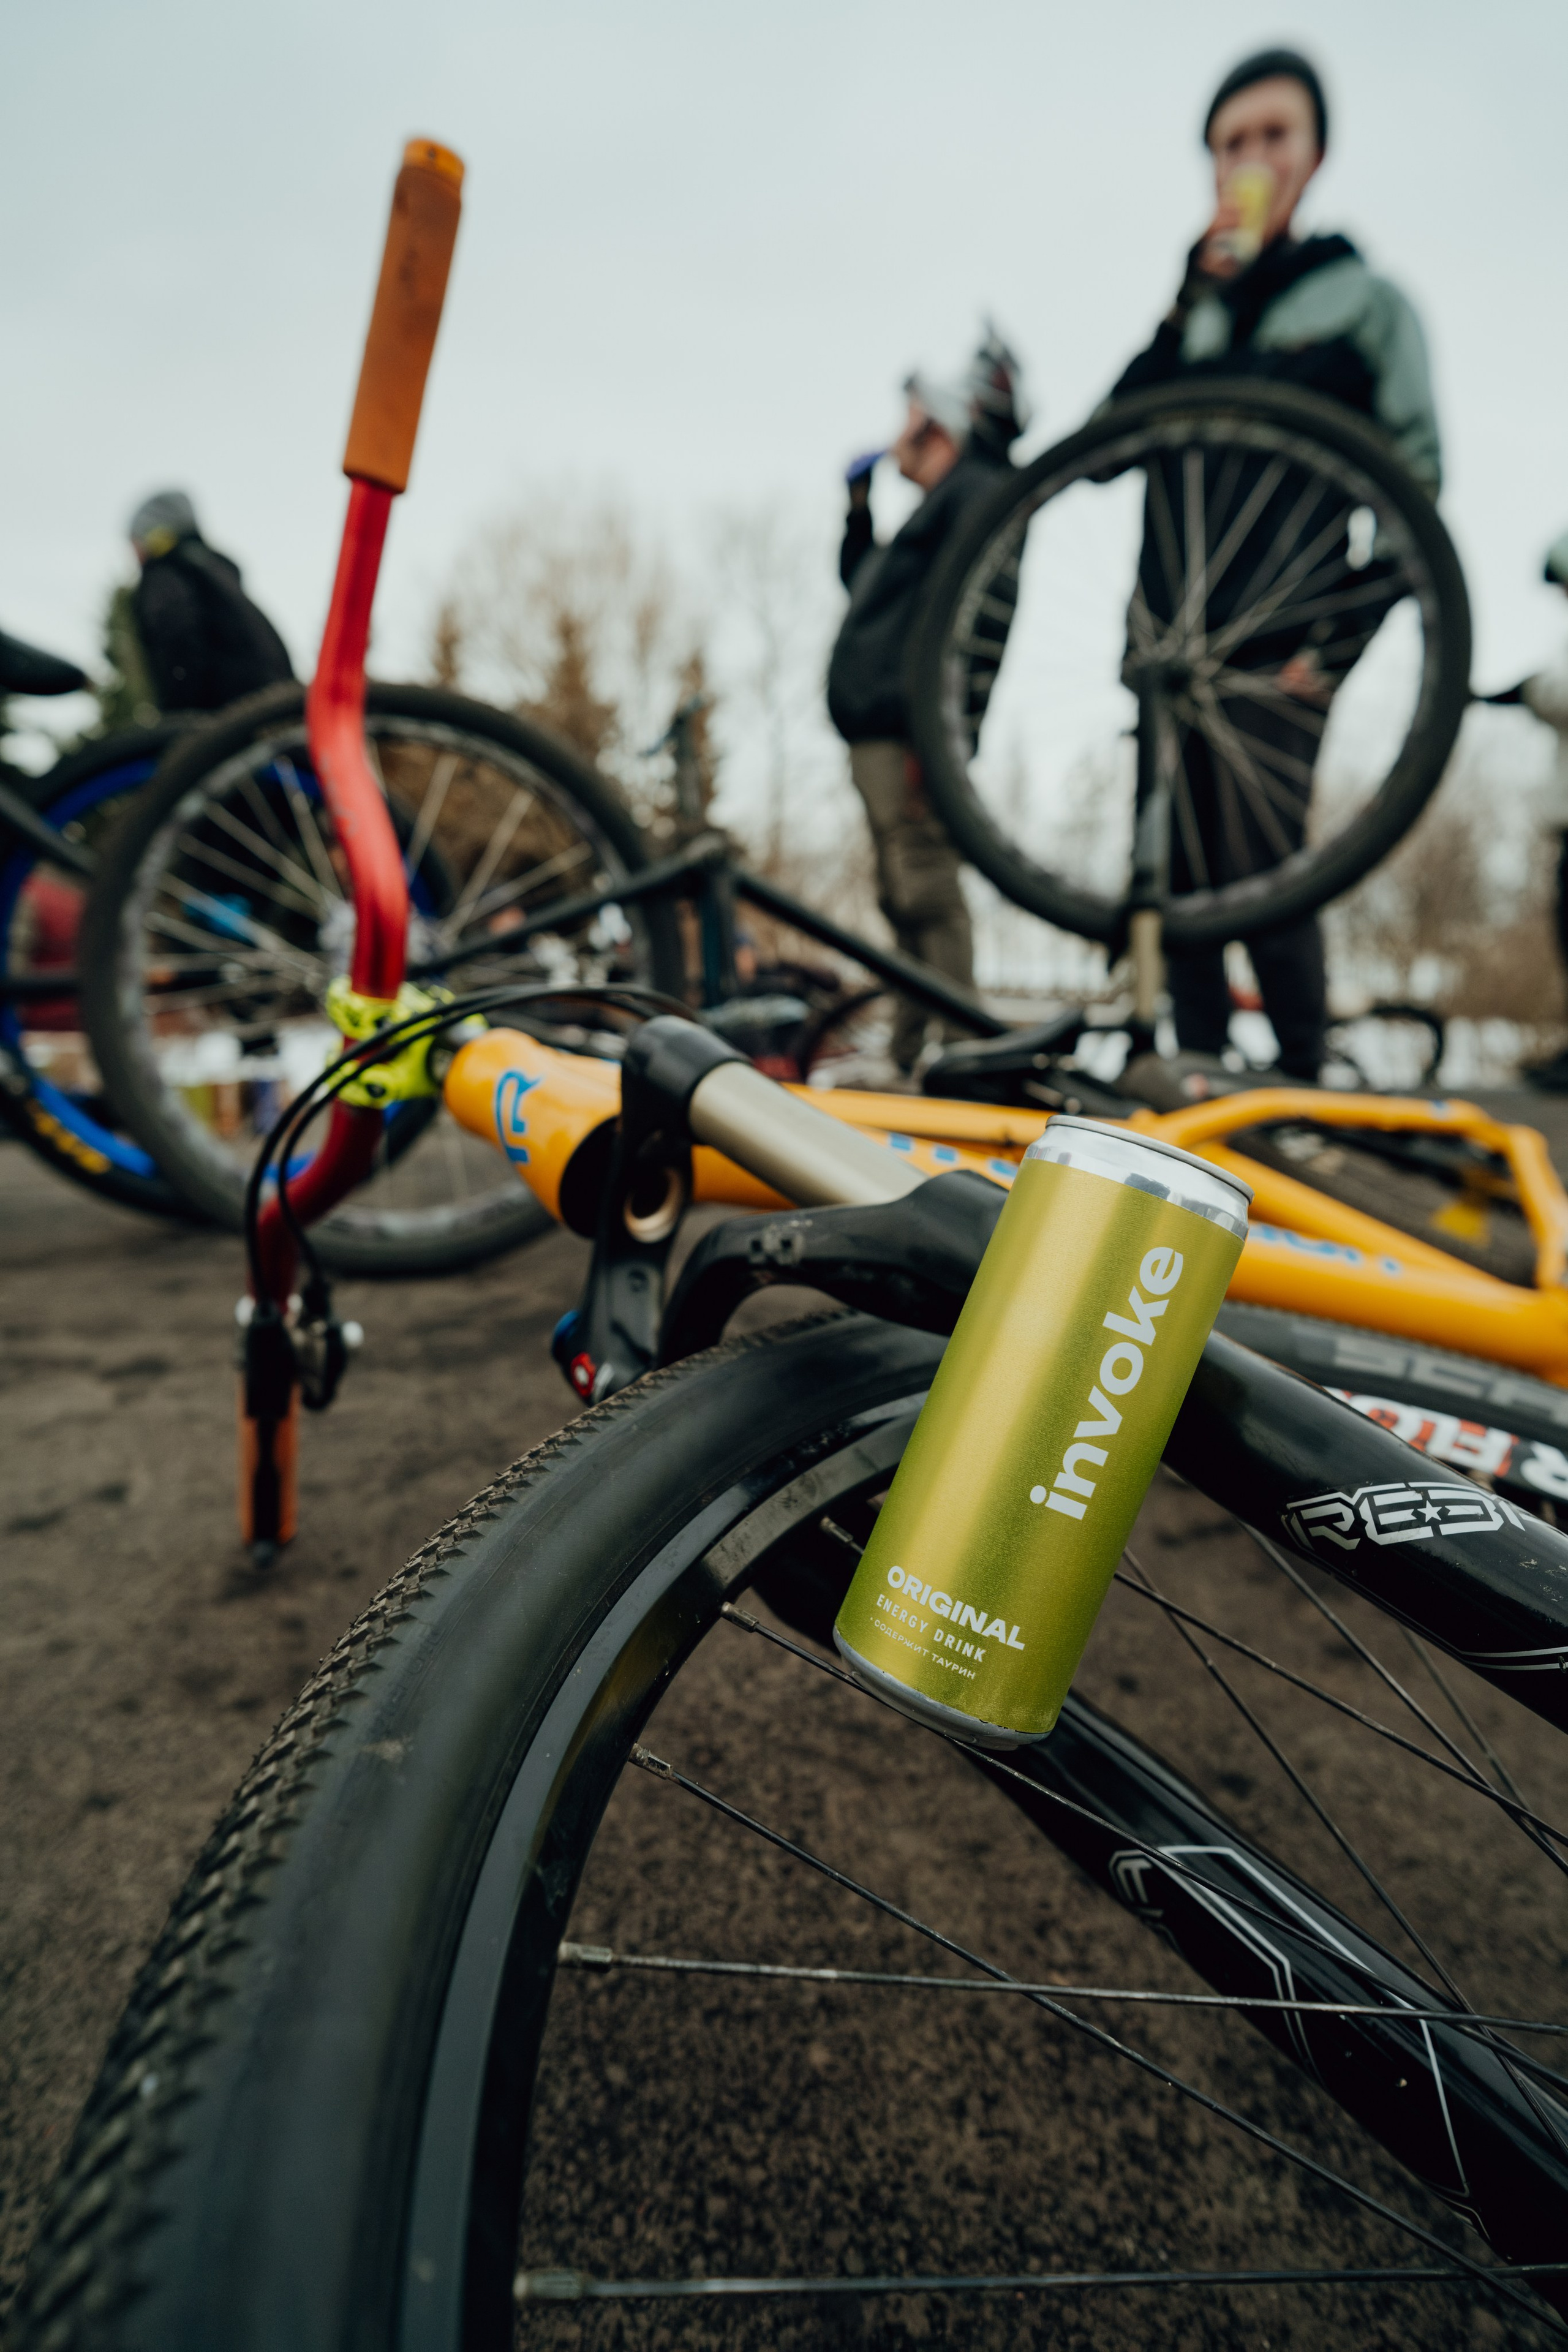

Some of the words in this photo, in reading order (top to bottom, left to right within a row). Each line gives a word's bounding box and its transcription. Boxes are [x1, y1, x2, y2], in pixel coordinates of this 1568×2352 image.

[1030, 1246, 1183, 1521] invoke
[876, 1594, 929, 1633] ENERGY
[933, 1629, 987, 1662] DRINK
[887, 1566, 1025, 1651] ORIGINAL
[931, 1653, 976, 1679] ТАУРИН
